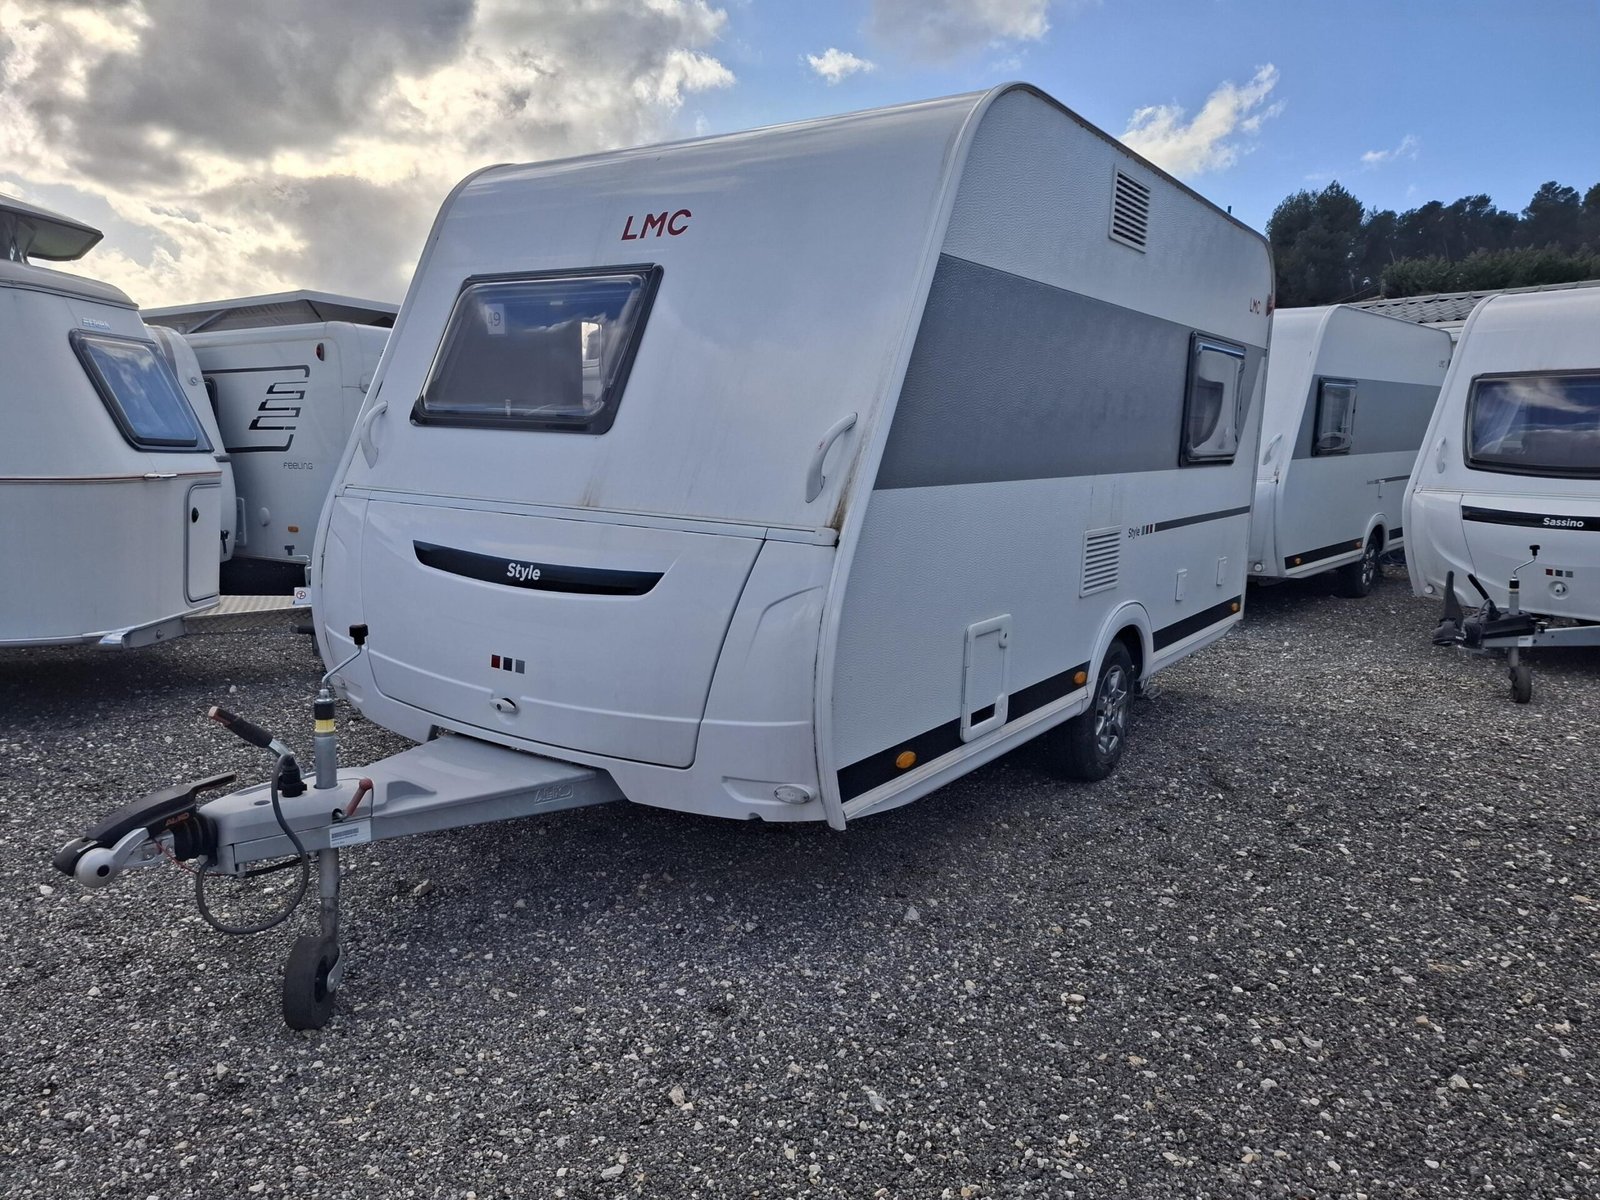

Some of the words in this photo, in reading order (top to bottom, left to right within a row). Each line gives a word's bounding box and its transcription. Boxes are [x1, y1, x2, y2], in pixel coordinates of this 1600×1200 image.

[621, 209, 692, 241] LMC
[488, 312, 501, 327] 49
[1542, 517, 1584, 528] Sassino
[1128, 527, 1141, 540] Style
[506, 562, 541, 582] Style
